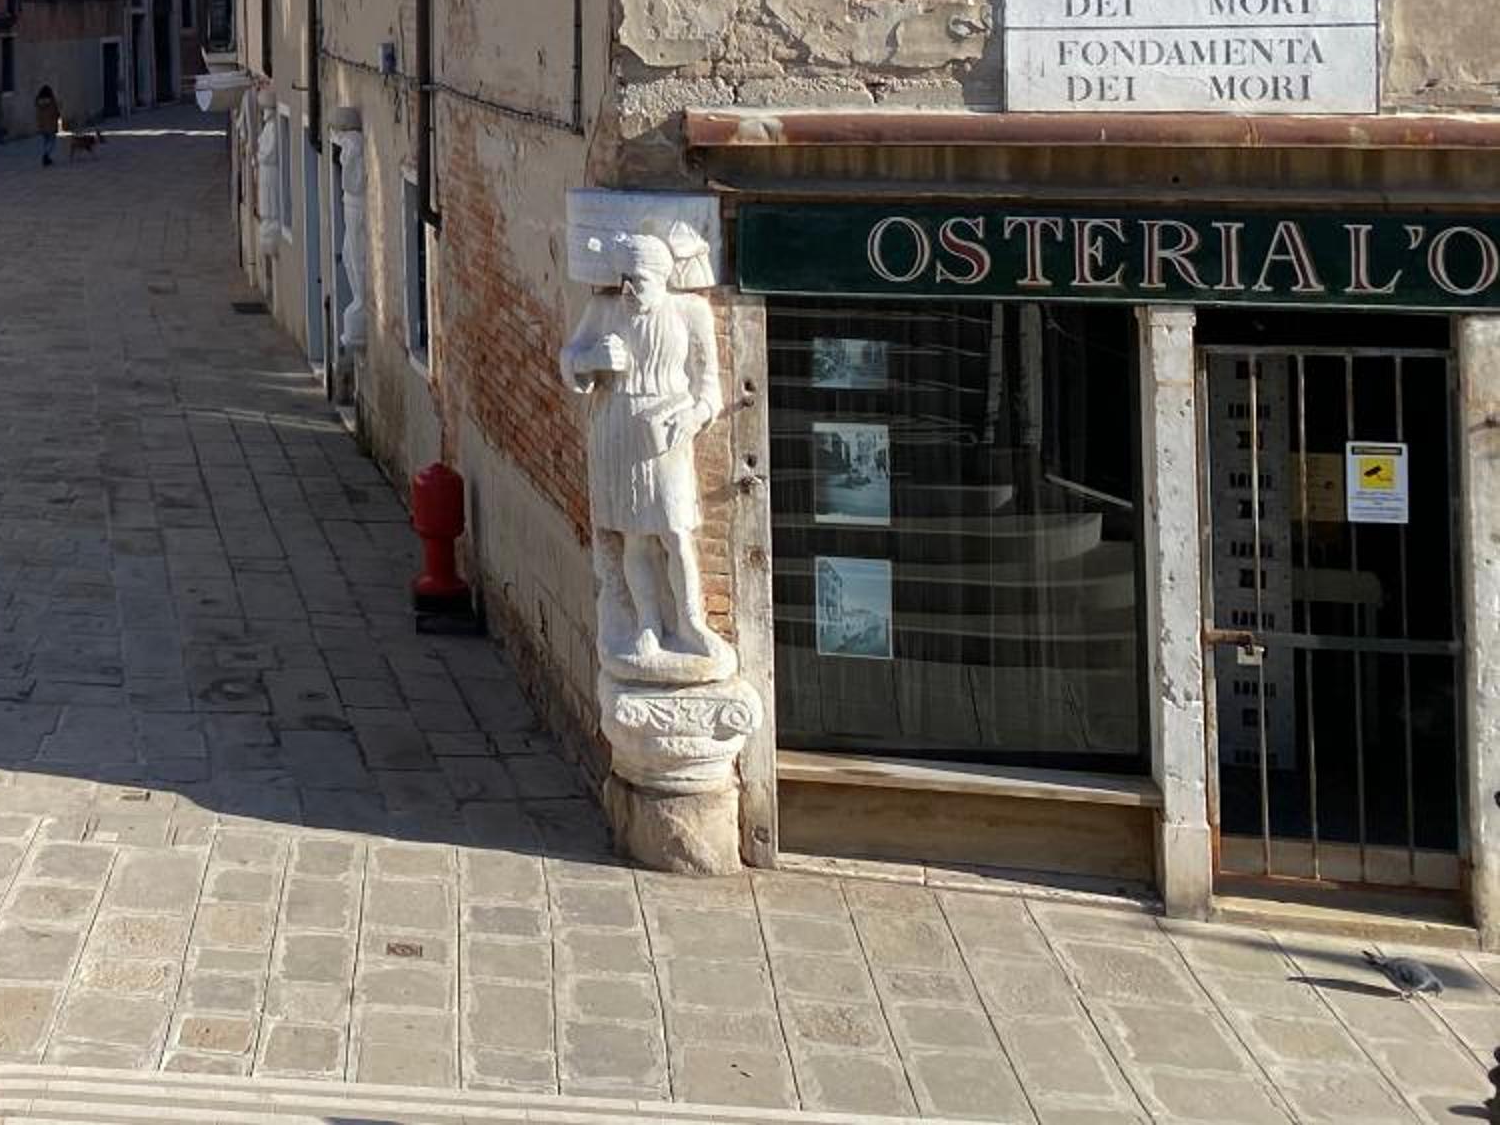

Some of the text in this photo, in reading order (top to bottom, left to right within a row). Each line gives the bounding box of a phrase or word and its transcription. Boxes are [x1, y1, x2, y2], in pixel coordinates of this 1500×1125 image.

[1057, 37, 1325, 67] FONDAMENTA
[1065, 74, 1313, 102] DEI MORI
[866, 216, 1500, 296] OSTERIA L'O
